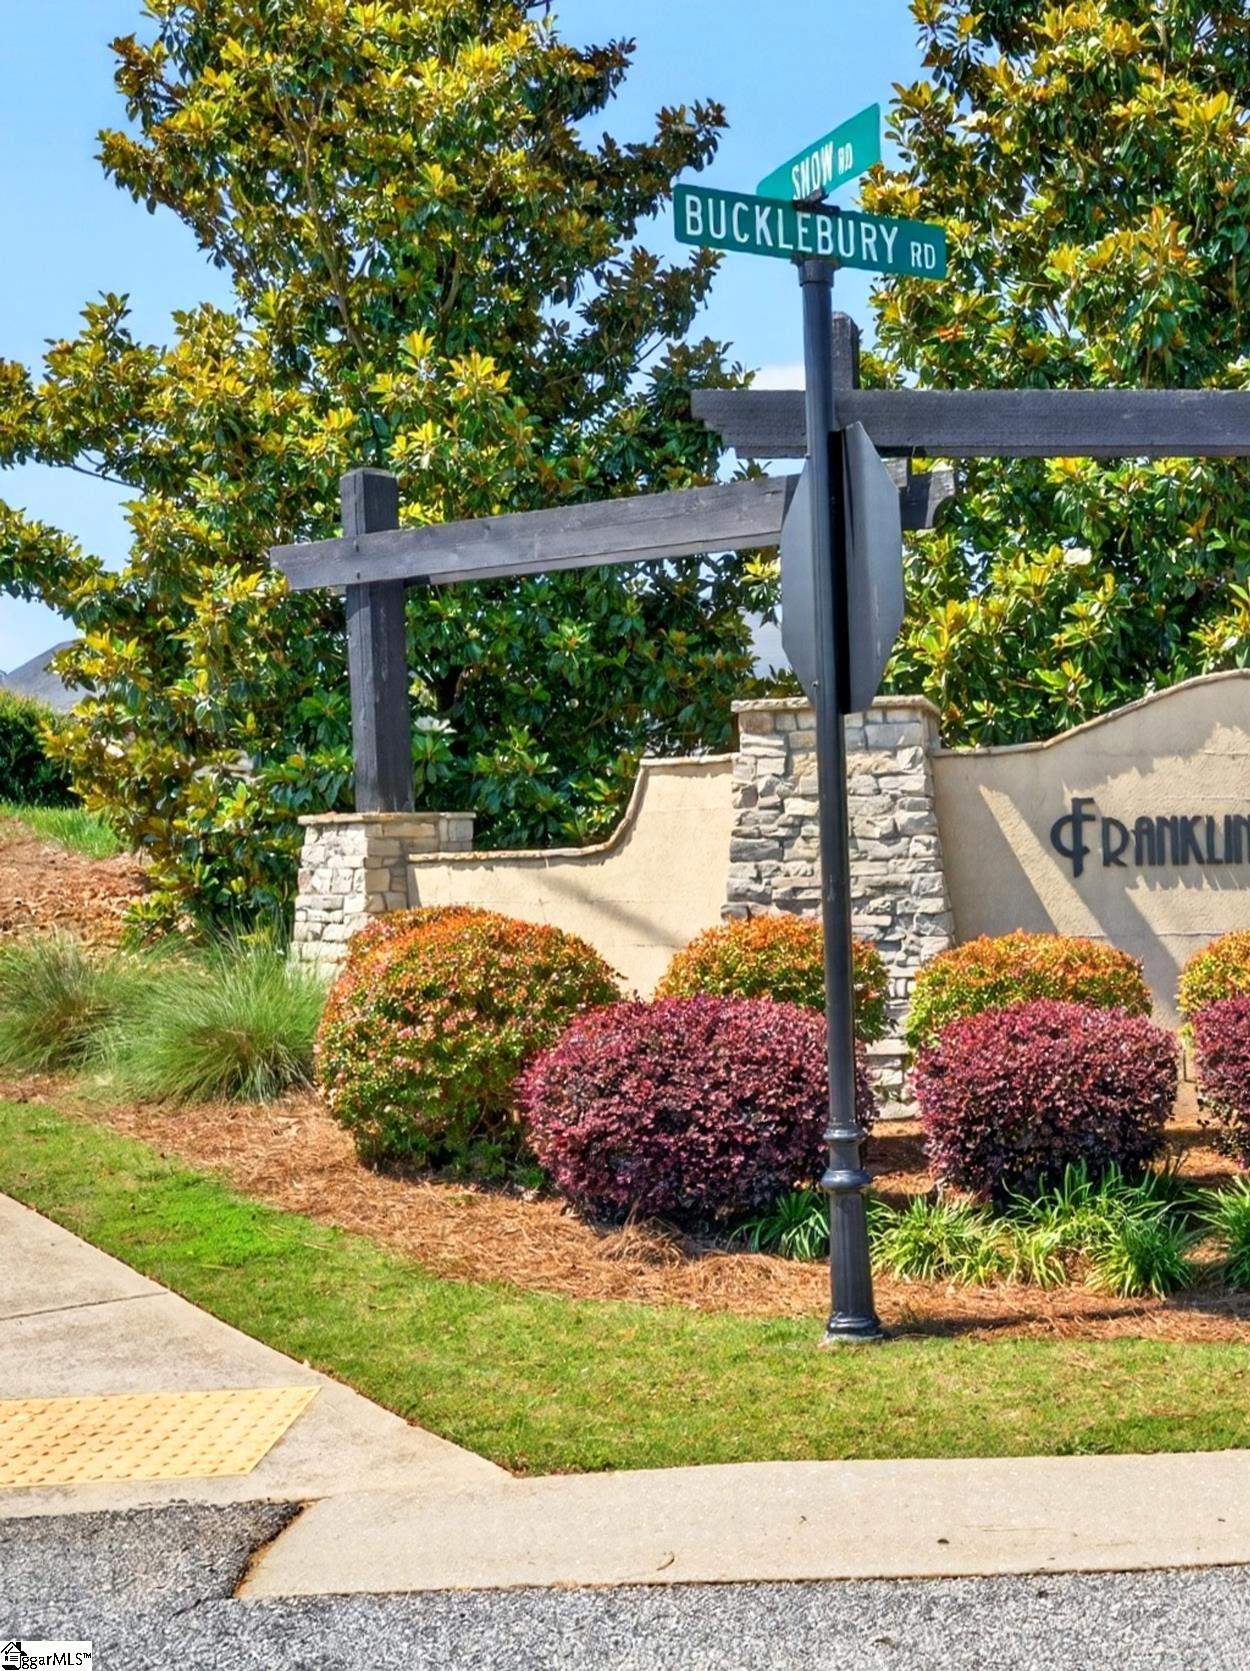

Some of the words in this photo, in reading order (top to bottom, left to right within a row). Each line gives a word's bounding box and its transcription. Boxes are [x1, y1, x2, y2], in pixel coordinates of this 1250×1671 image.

[791, 141, 834, 200] SNOW
[838, 142, 854, 175] RD
[685, 194, 898, 265] BUCKLEBURY
[911, 240, 936, 270] RD
